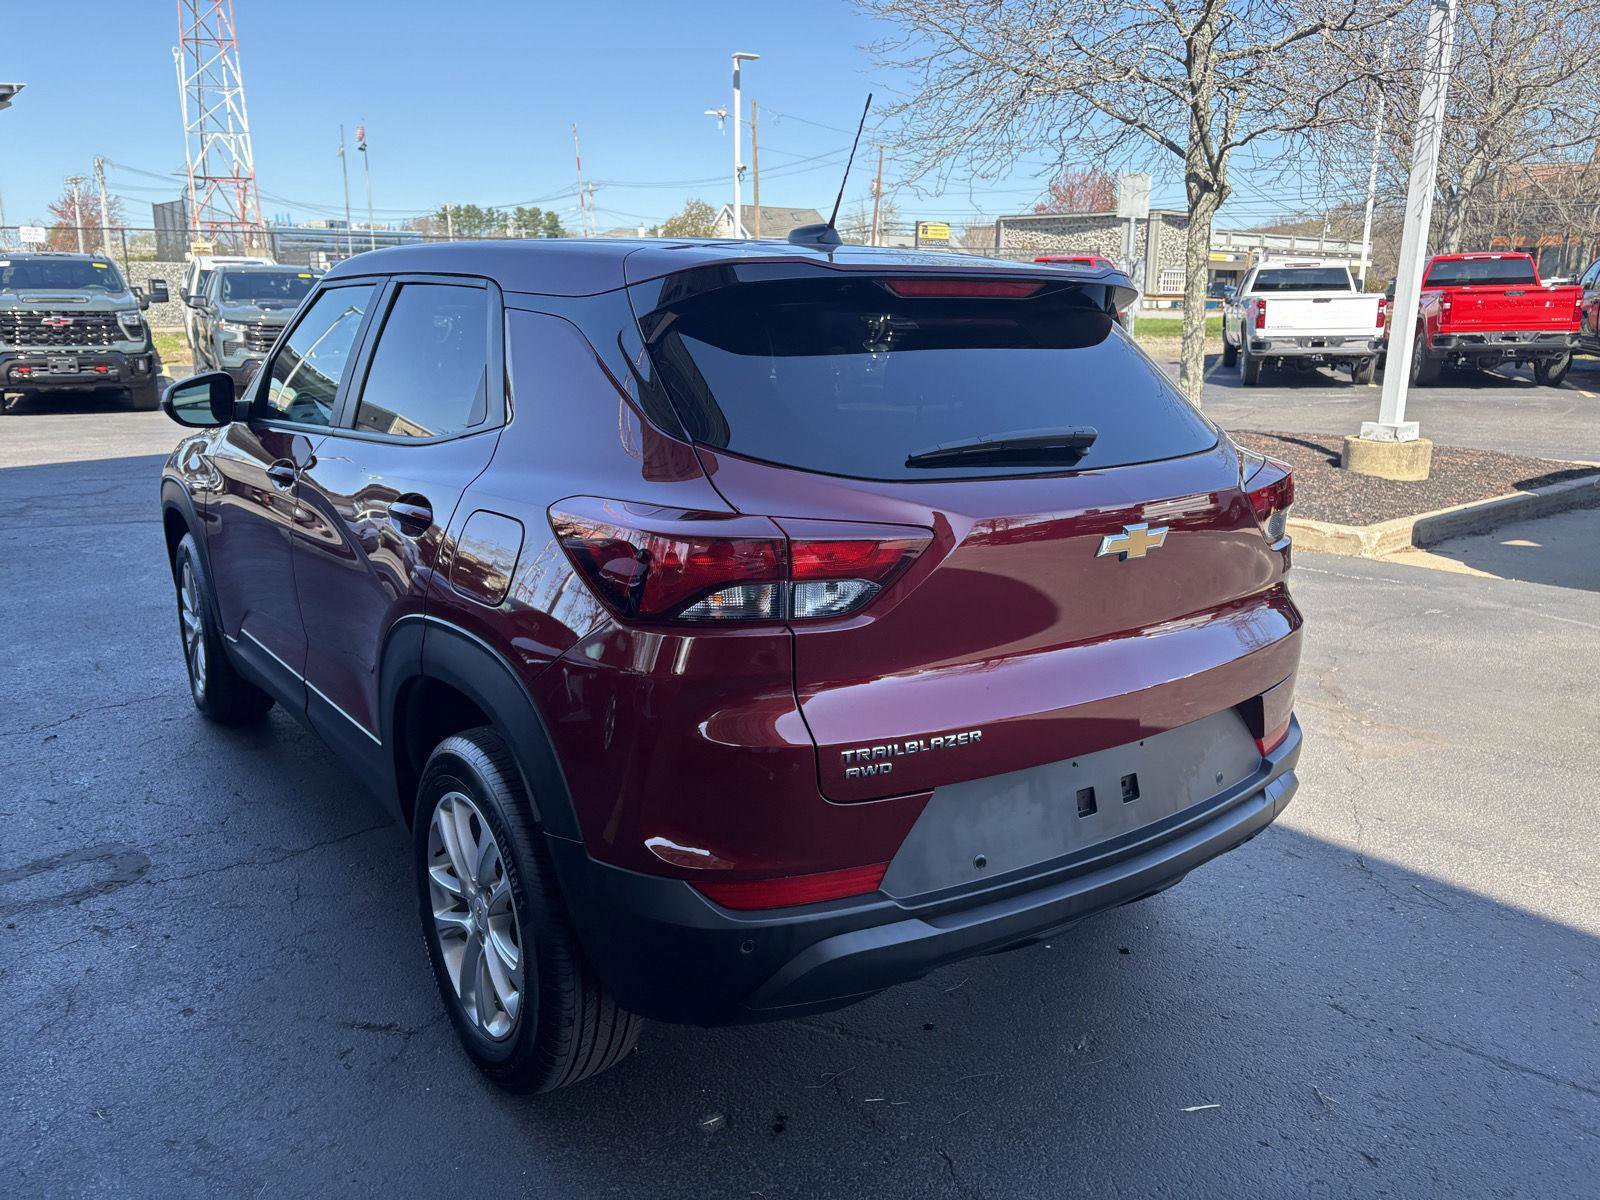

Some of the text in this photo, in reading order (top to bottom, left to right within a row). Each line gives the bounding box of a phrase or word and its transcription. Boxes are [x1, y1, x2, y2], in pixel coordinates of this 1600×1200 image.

[841, 730, 982, 763] TRAILBLAZER
[845, 762, 893, 780] AWD
[480, 790, 522, 895] ntinental
